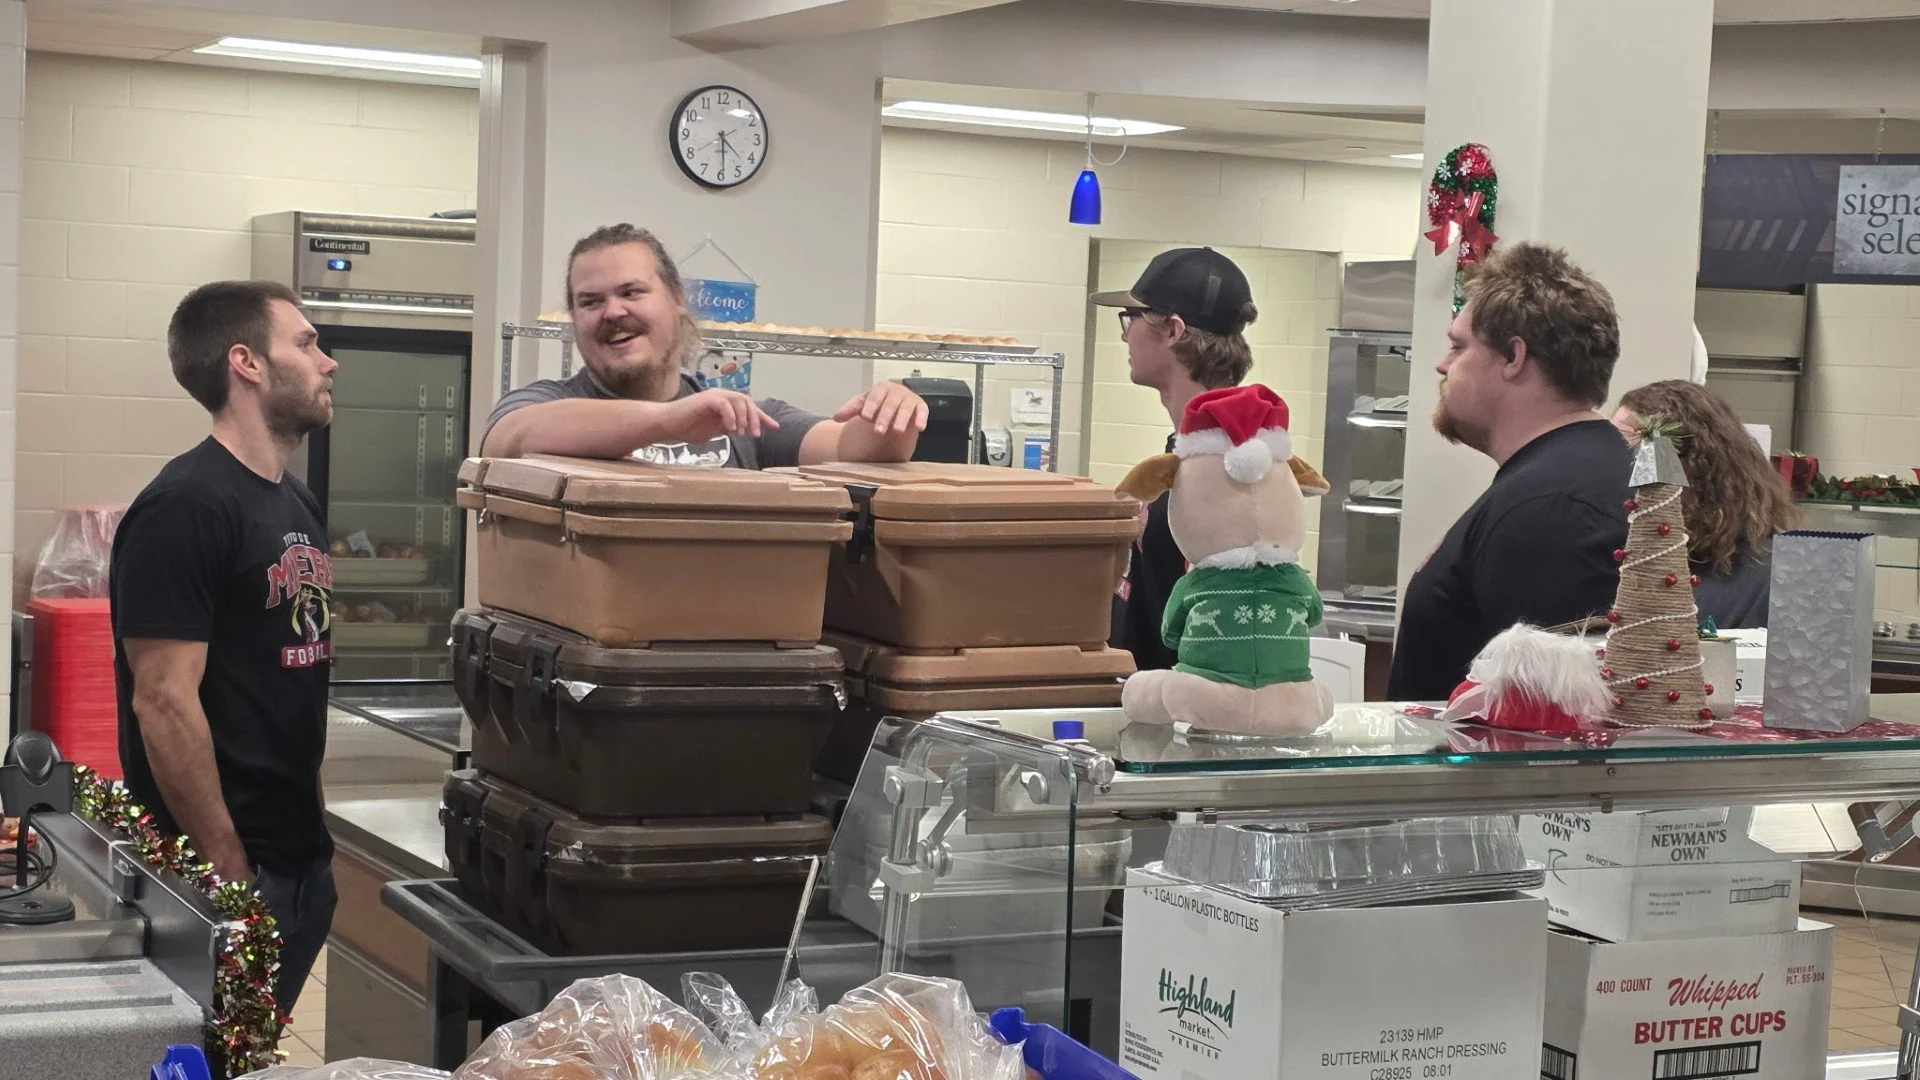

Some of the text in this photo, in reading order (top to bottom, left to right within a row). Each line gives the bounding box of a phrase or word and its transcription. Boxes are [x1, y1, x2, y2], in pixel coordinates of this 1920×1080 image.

[702, 97, 711, 110] 11
[717, 92, 730, 105] 12
[686, 109, 698, 122] 10
[748, 114, 757, 127] 2
[682, 128, 690, 141] 9
[753, 134, 761, 146] 3
[686, 147, 695, 160] 8
[747, 152, 755, 164] 4
[700, 163, 708, 176] 7
[717, 170, 725, 181] 6
[734, 166, 742, 178] 5
[314, 239, 366, 251] Continental
[688, 287, 750, 311] elcome
[1534, 811, 1592, 833] WMAN'S
[1542, 822, 1572, 842] OWN
[1651, 829, 1728, 848] NEWMAN'S
[1671, 846, 1706, 862] OWN
[1143, 886, 1148, 896] 4
[1154, 888, 1159, 900] 1
[1160, 889, 1190, 911] GALLON
[1191, 899, 1222, 921] PLASTIC
[1224, 909, 1259, 933] BOTTLES
[1596, 977, 1653, 994] 400 COUNT
[1667, 972, 1764, 1011] Whipped
[1159, 967, 1236, 1029] Highland
[1179, 1019, 1211, 1040] market
[1379, 1026, 1444, 1044] 23139 HMP
[1634, 1010, 1787, 1045] BUTTER CUPS
[1171, 1035, 1220, 1061] PREMIER
[1321, 1041, 1507, 1067] BUTTERMILK RANCH DRESSING
[1370, 1063, 1452, 1080] C28925 08:01
